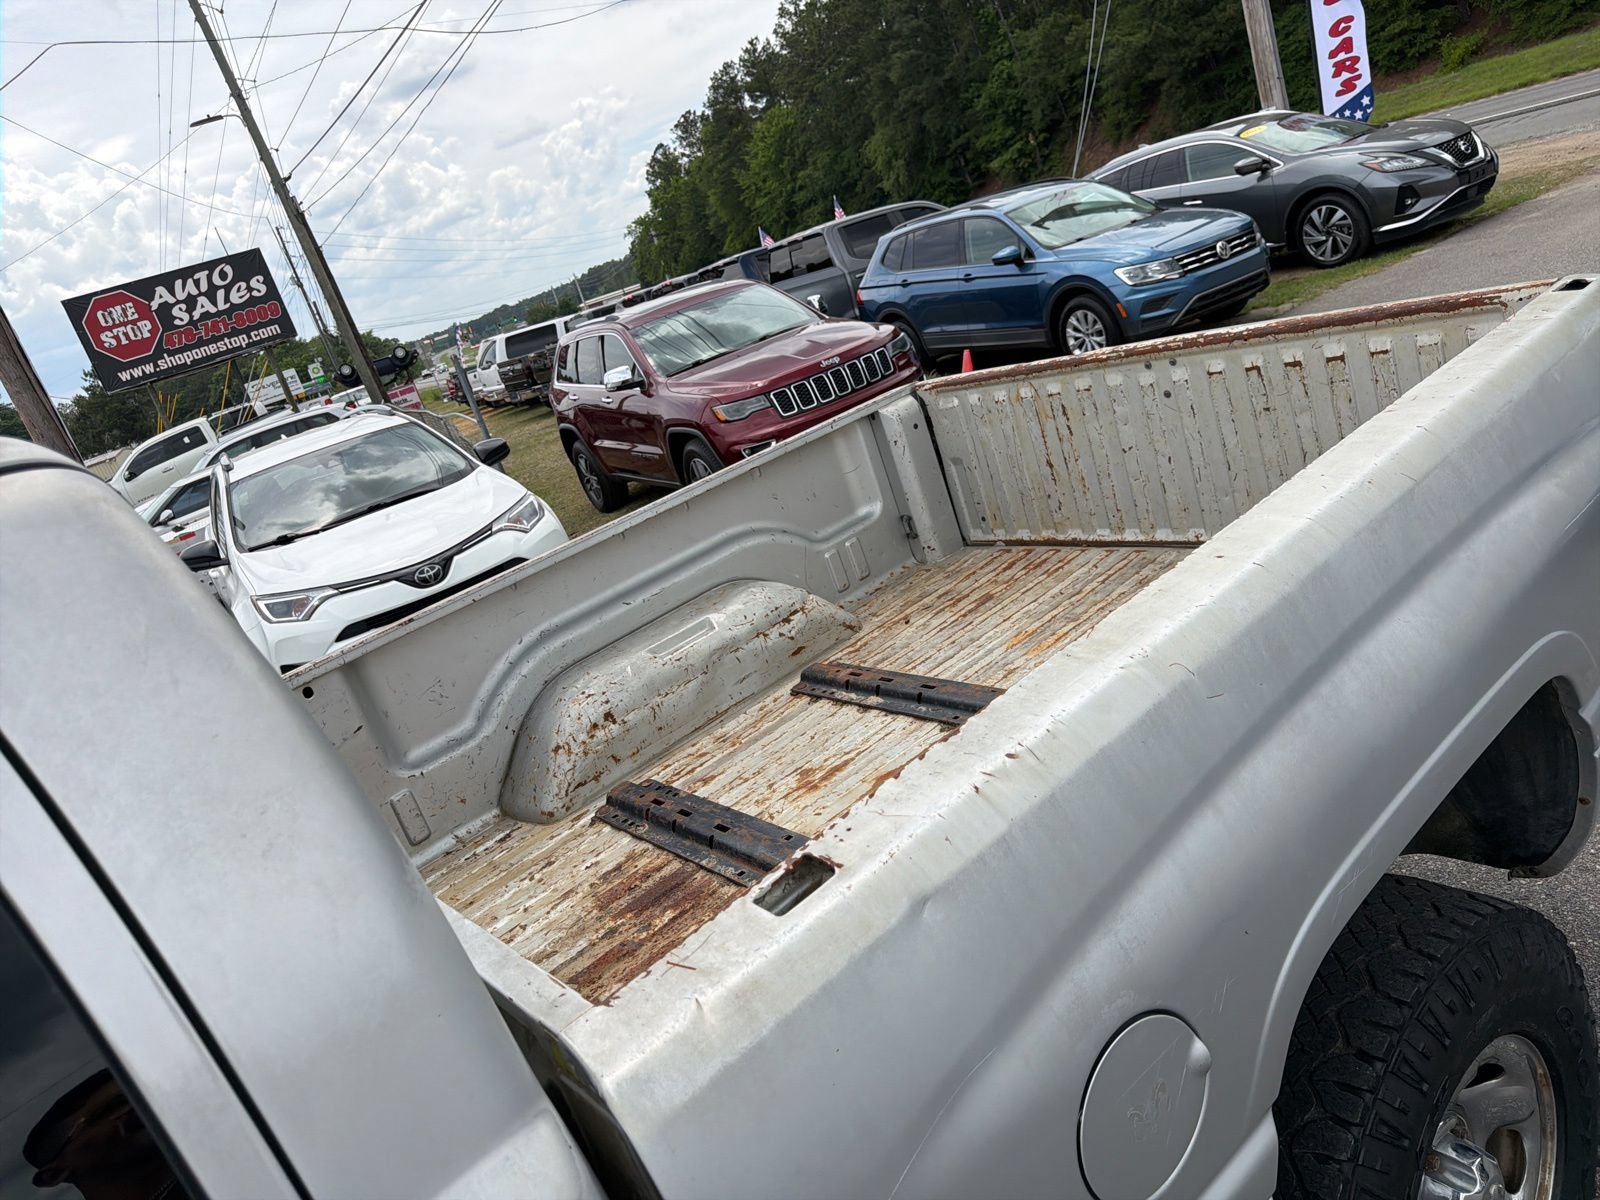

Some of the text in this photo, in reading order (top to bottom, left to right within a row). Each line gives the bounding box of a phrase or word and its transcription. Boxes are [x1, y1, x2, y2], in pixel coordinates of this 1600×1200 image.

[1327, 15, 1362, 97] CARS
[150, 263, 233, 311] AUTO
[96, 302, 139, 327] ONE
[100, 320, 152, 348] STOP
[163, 301, 282, 349] 478-741-8009
[117, 324, 281, 382] www.shoponestop.com
[820, 356, 840, 368] Jeep
